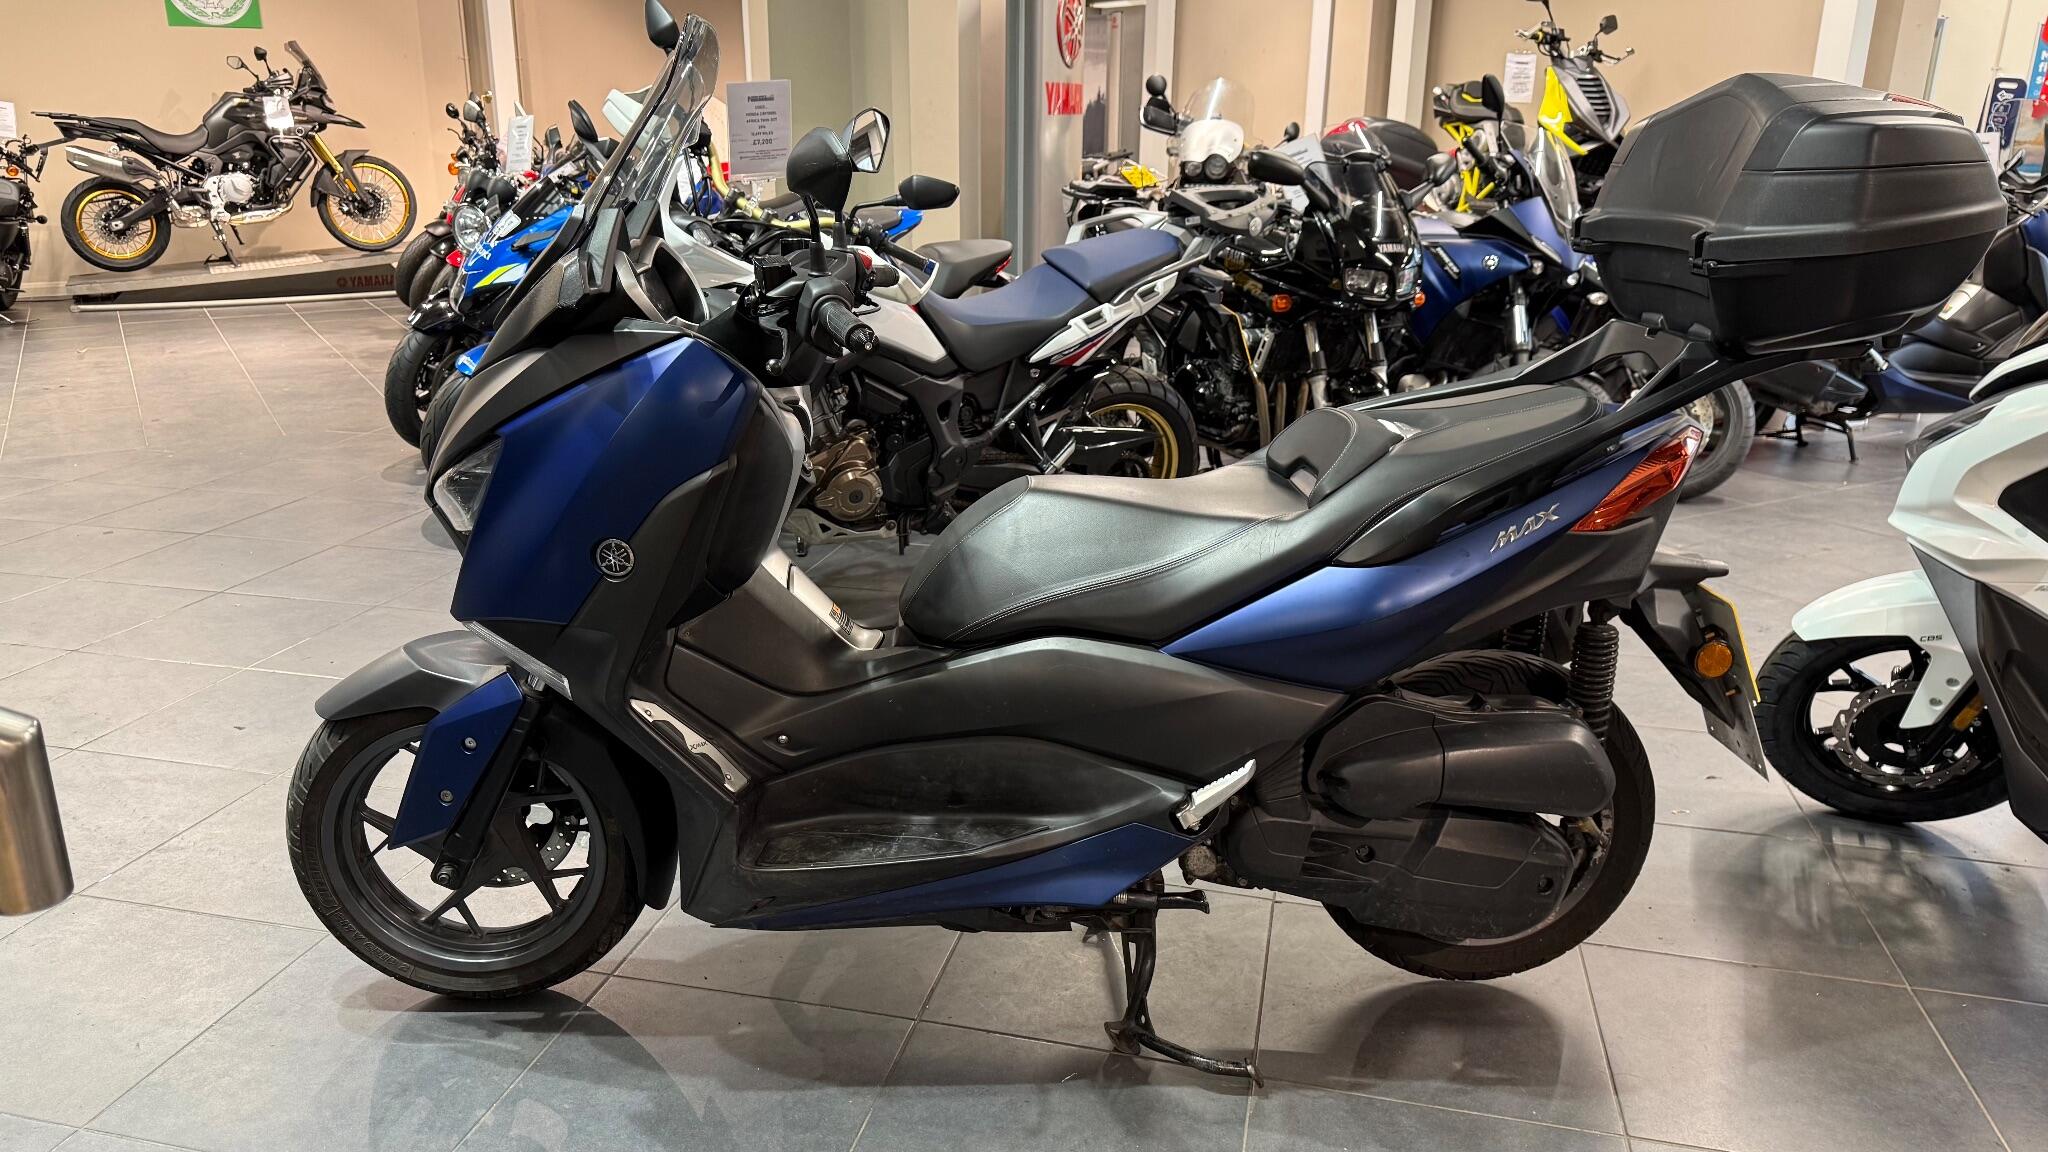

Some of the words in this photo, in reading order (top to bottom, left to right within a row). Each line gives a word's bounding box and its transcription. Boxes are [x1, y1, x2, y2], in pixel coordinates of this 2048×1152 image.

[1045, 82, 1083, 115] YAMAH
[1377, 243, 1406, 254] YAMAHA
[1490, 502, 1561, 553] MAX
[1920, 635, 1943, 643] CBS
